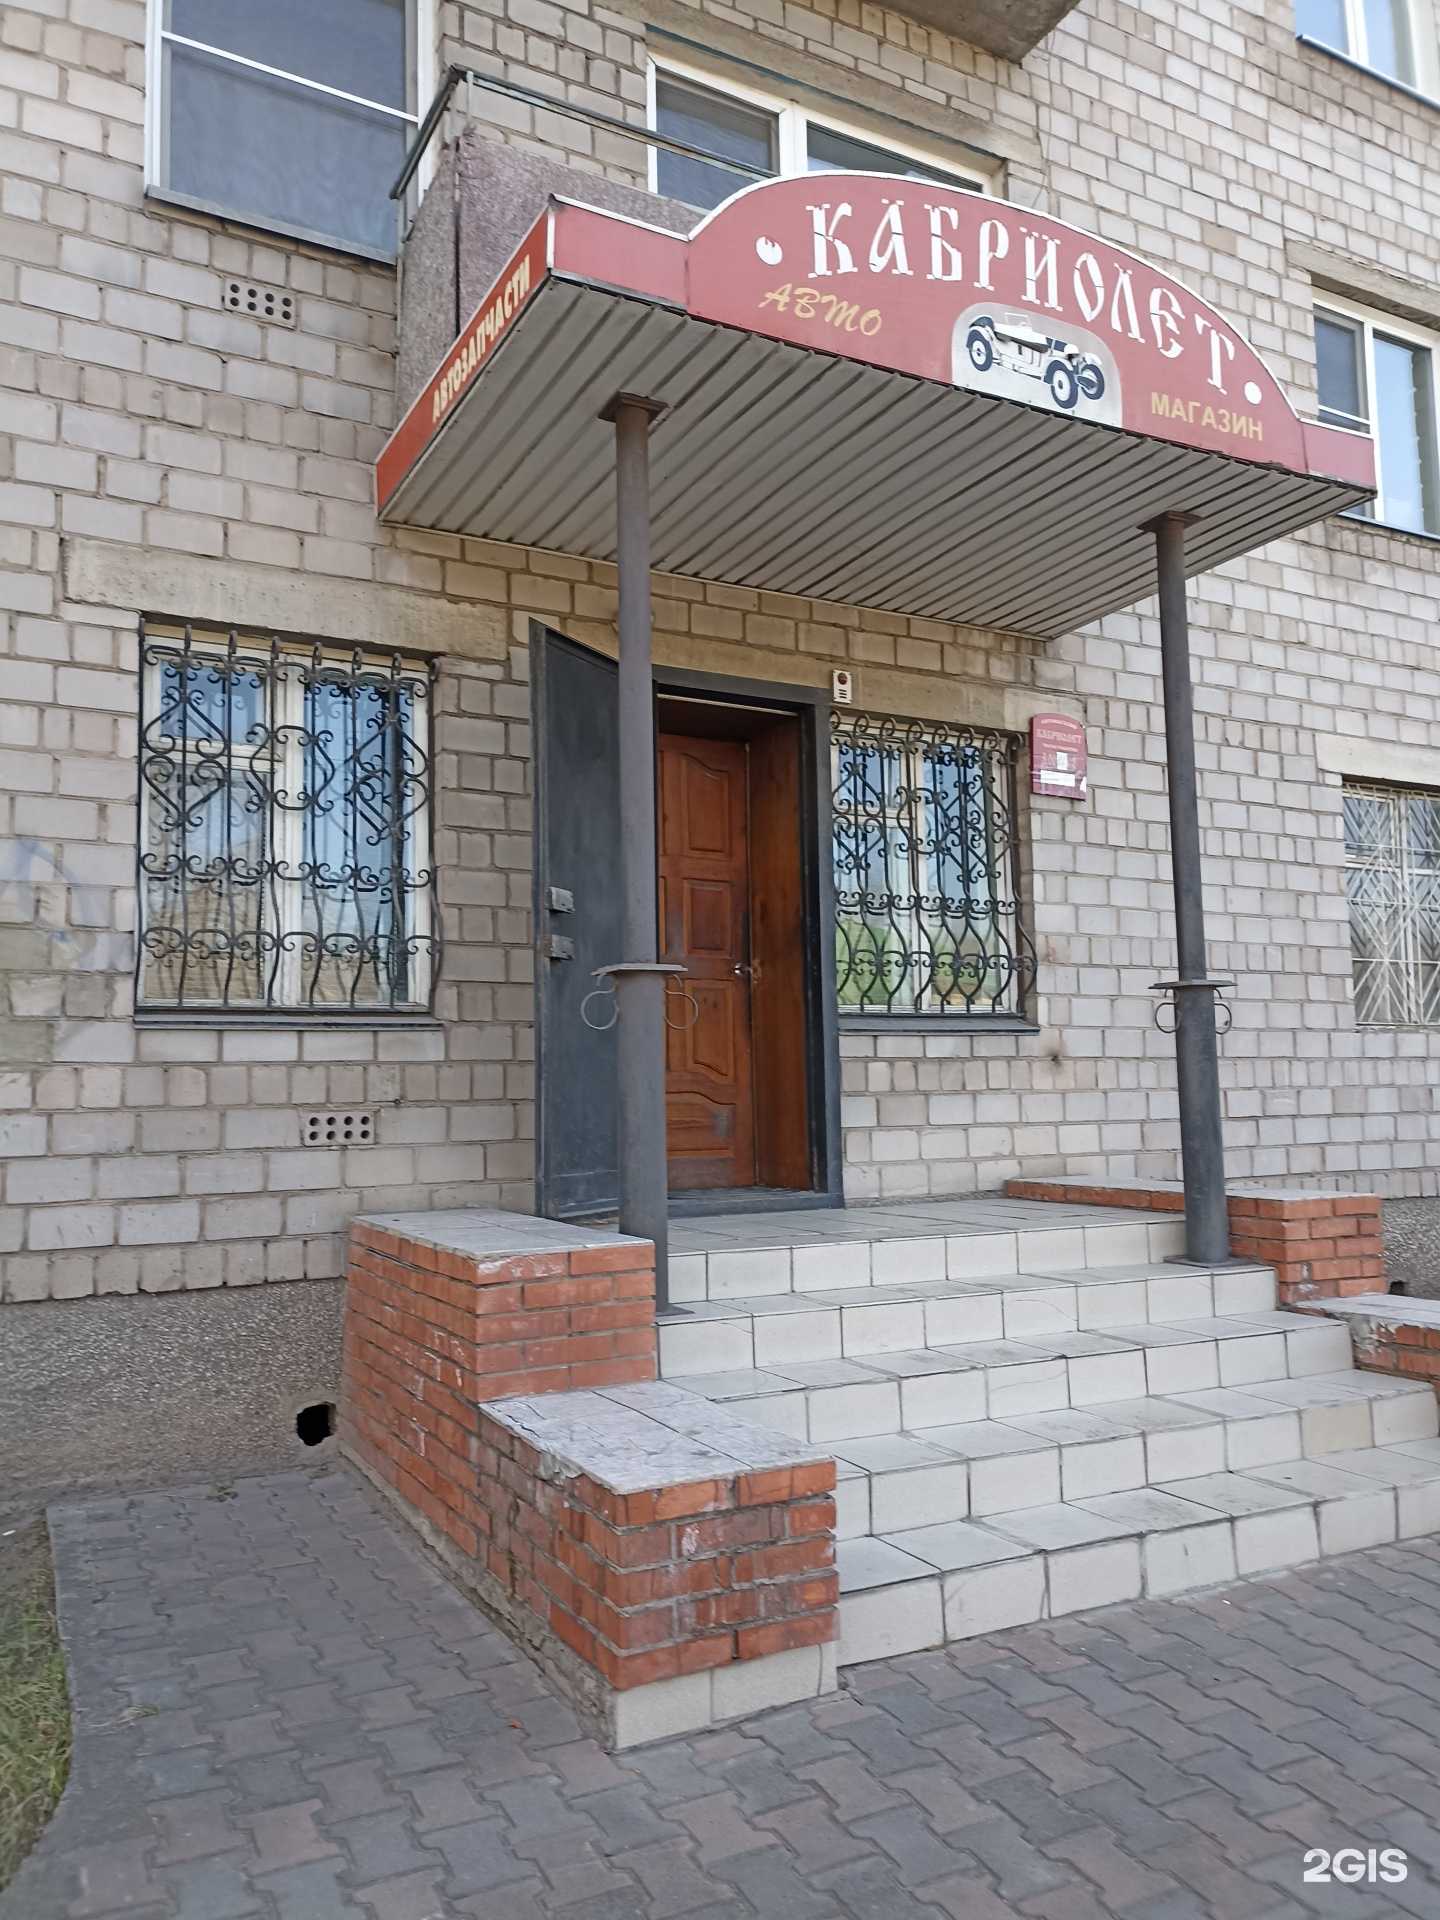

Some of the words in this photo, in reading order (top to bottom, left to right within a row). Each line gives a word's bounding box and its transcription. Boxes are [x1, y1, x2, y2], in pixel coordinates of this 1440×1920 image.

[432, 253, 531, 423] АВТОЗАПЧАСТИ
[805, 198, 1237, 396] КАБРИОЛЕТ
[1151, 391, 1263, 441] МАГАЗИН
